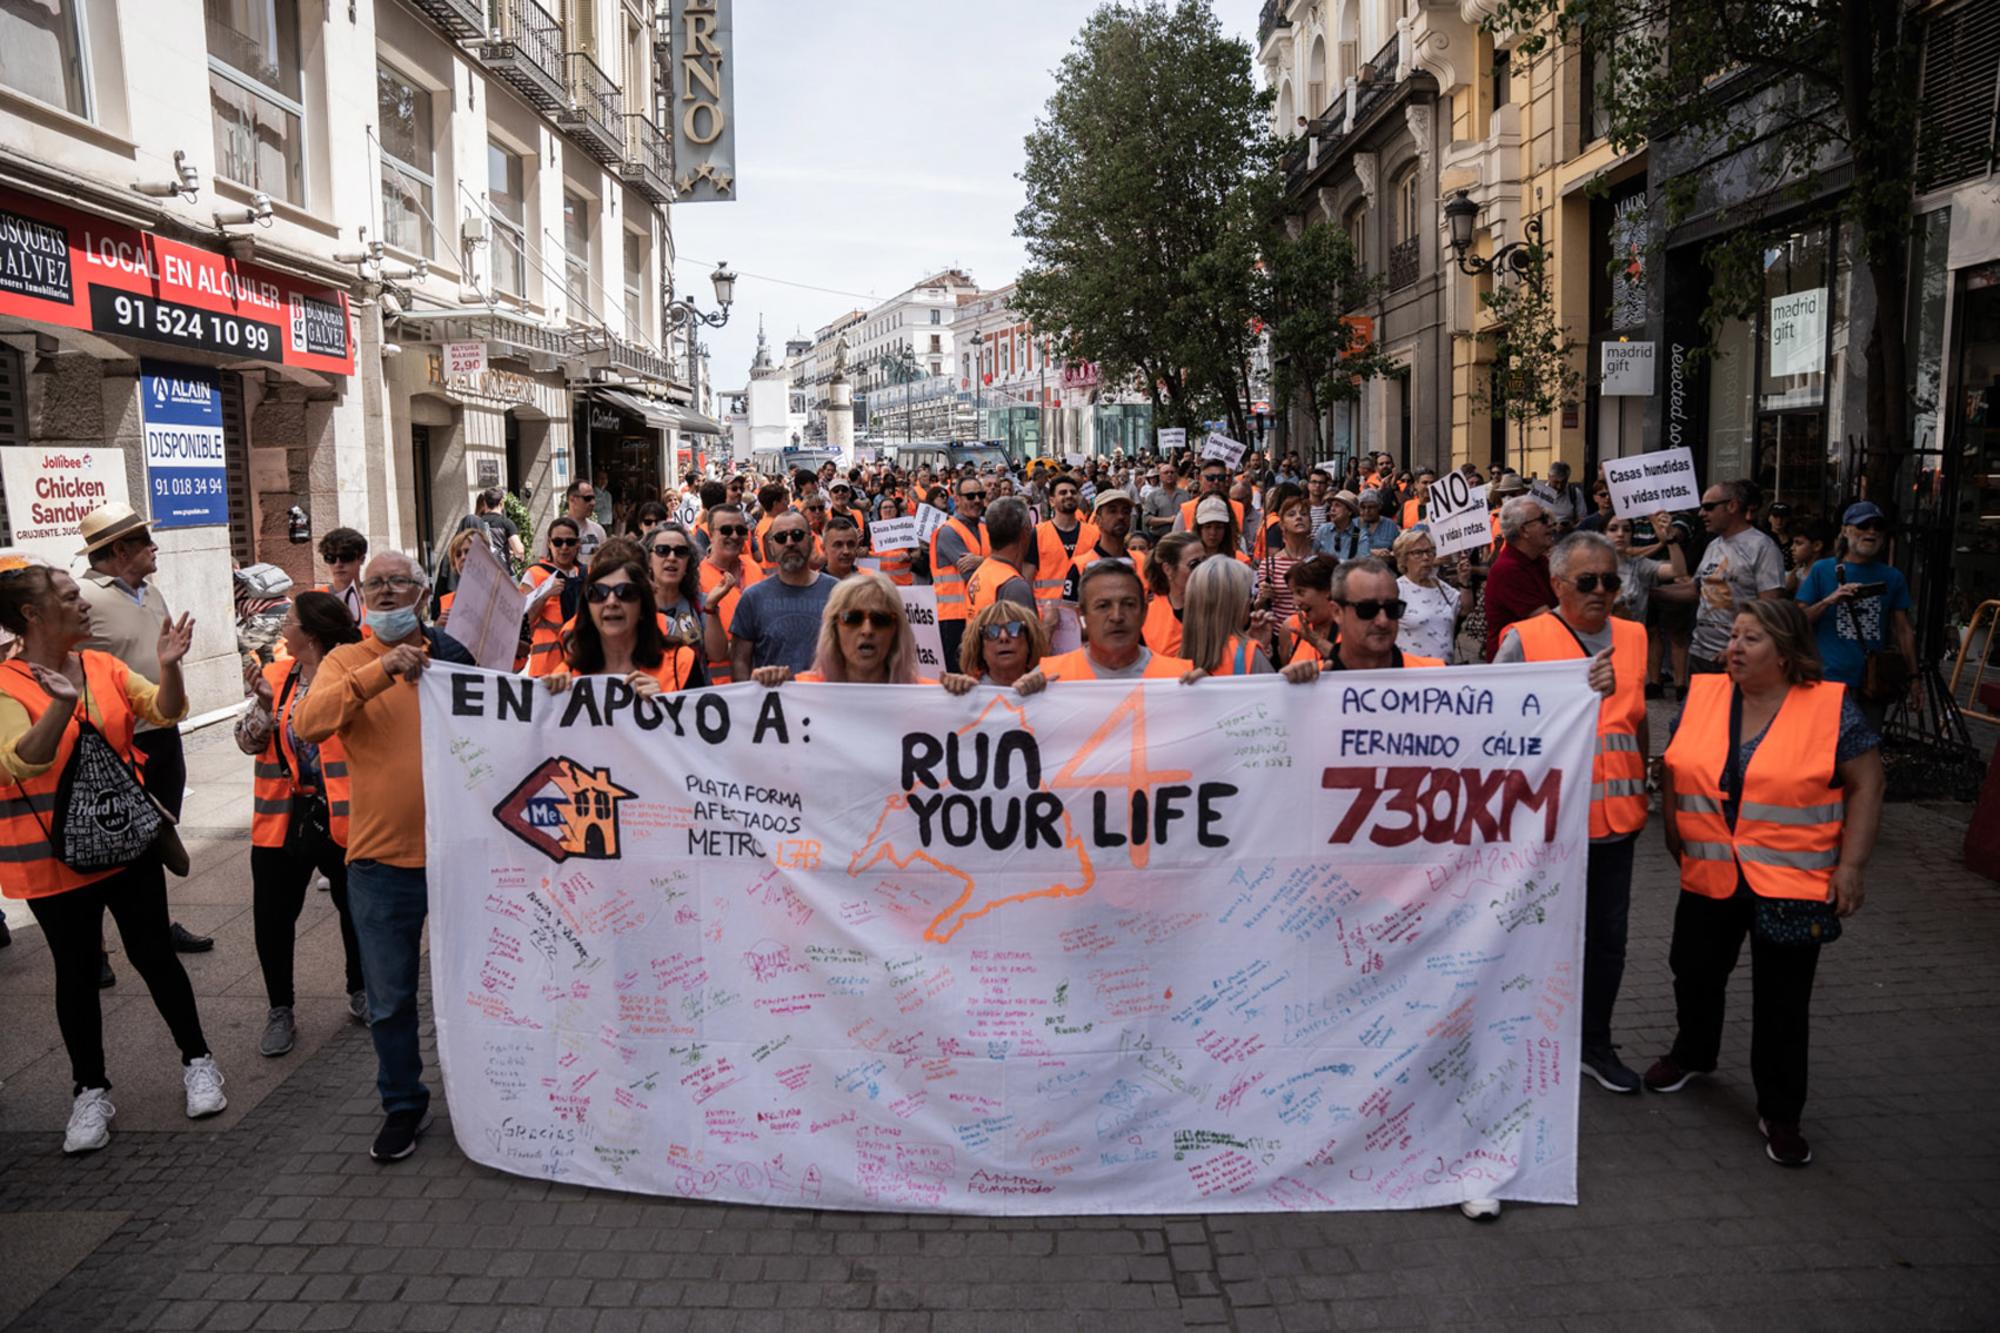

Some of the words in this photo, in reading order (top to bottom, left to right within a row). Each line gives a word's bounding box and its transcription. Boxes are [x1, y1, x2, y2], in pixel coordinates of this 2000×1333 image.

[0, 247, 69, 289] ALVEZ
[85, 231, 160, 280] LOCAL
[164, 254, 193, 289] EN
[197, 265, 281, 311] ALQUILER
[1773, 294, 1816, 321] madrid
[114, 296, 146, 329] 91
[156, 305, 203, 340] 524
[210, 317, 239, 346] 10
[245, 326, 270, 352] 99
[307, 320, 346, 348] GALVEZ
[1774, 321, 1796, 346] gift
[1607, 345, 1653, 358] madrid
[452, 360, 481, 372] 2,90
[1607, 360, 1630, 375] gift
[171, 379, 211, 400] ALAIN
[149, 431, 223, 460] DISPONIBLE
[42, 455, 81, 469] Jollibee
[1610, 468, 1642, 484] Casas
[1643, 459, 1690, 477] hundidas
[36, 475, 105, 500] Chicken
[155, 478, 169, 496] 91
[172, 478, 193, 495] 018
[194, 478, 208, 495] 34
[209, 477, 222, 494] 94
[1430, 472, 1469, 518] NO
[1622, 495, 1630, 509] y
[1632, 489, 1660, 504] vidas
[1661, 485, 1691, 499] rotas.
[872, 524, 890, 535] Casas
[890, 521, 915, 531] hundidas
[884, 536, 899, 545] vidas
[1440, 533, 1446, 547] y
[1446, 528, 1463, 541] vidas
[1464, 522, 1486, 537] rotas.
[916, 643, 940, 665] tas.
[451, 672, 533, 722] EN
[560, 676, 731, 745] APOYO
[752, 691, 810, 744] A:
[1341, 685, 1494, 716] ACOMPAÑA
[1521, 693, 1541, 717] A
[1341, 729, 1460, 758] FERNANDO
[1483, 730, 1543, 757] CÁLIZ
[1050, 682, 1193, 870] 4
[77, 801, 110, 817] Hard
[113, 792, 141, 815] Rock
[685, 774, 803, 812] PLATAFORMA
[694, 801, 801, 834] AFECTADOS
[906, 792, 1064, 851] YOUR
[1093, 782, 1239, 848] LIFE
[1321, 766, 1563, 848] 730KM
